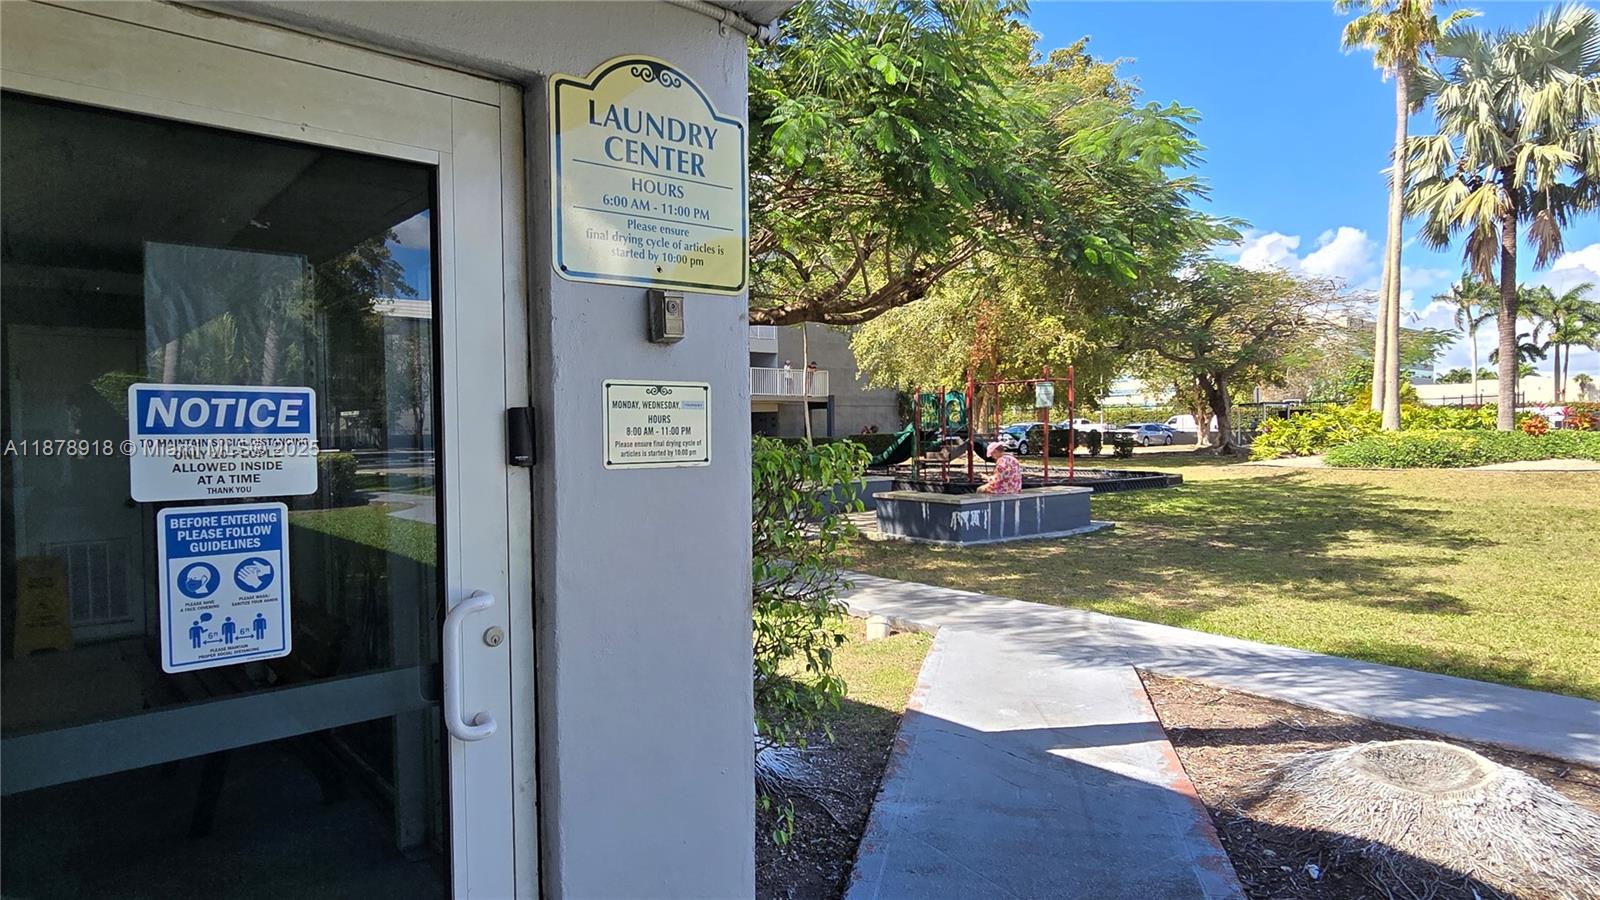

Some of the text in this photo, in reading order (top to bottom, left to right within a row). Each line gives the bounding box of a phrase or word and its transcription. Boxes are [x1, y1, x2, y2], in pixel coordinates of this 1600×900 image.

[589, 99, 718, 150] LAUNDRY
[604, 136, 706, 177] CENTER
[631, 177, 684, 199] HOURS
[602, 194, 628, 208] 6:00
[630, 198, 650, 212] AM
[661, 203, 690, 218] 11:00
[693, 208, 711, 221] PM
[627, 219, 690, 237] Please ensure
[586, 228, 725, 256] final drying cycle of articles is
[611, 247, 704, 267] started by 10:00 pm
[146, 397, 303, 428] NOTICE
[612, 400, 641, 410] MONDAY,
[642, 401, 681, 410] WEDNESDAY,
[648, 415, 671, 424] HOURS
[626, 427, 642, 436] 8:00
[643, 427, 654, 436] AM
[661, 426, 680, 435] 11:00
[681, 426, 692, 435] PM
[666, 440, 681, 448] drying
[682, 440, 695, 448] cycle
[667, 449, 674, 457] by
[172, 460, 283, 473] ALLOWED INSIDE
[197, 474, 261, 485] AT A TIME
[207, 486, 252, 495] THANK YOU
[170, 512, 277, 529] BEFORE ENTERING
[178, 525, 272, 541] PLEASE FOLLOW
[190, 537, 261, 552] GUIDELINES
